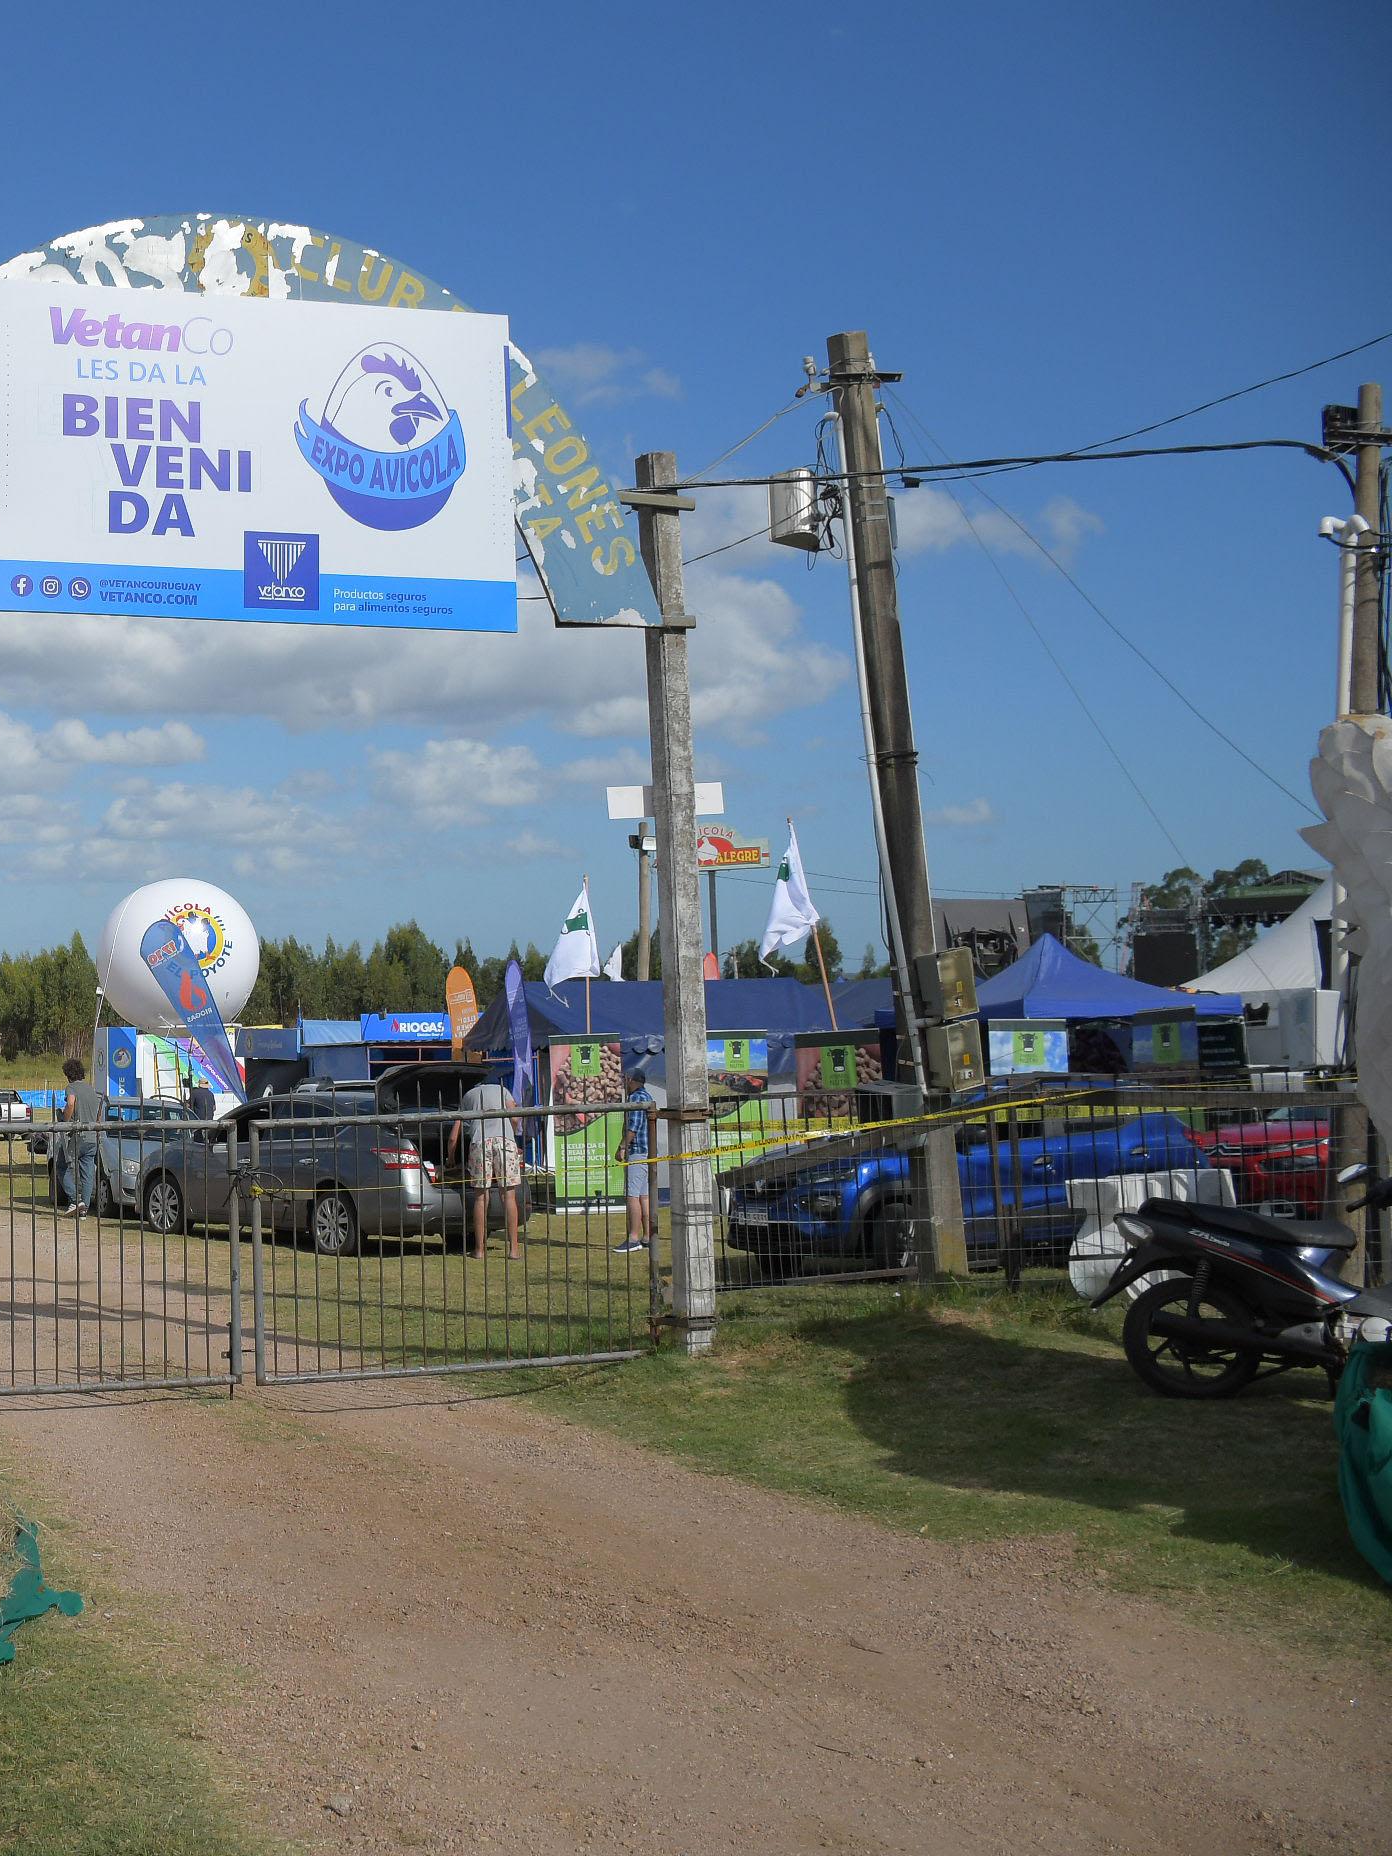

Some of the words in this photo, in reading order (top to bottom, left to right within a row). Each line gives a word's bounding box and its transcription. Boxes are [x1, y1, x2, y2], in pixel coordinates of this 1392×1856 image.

[49, 306, 233, 356] VetanCo
[76, 358, 119, 380] LES
[128, 361, 165, 384] DA
[175, 364, 207, 386] LA
[62, 393, 201, 443] BIEN
[110, 443, 252, 493] VENI
[310, 434, 365, 485] EXPO
[369, 433, 461, 493] AVICOLA
[108, 490, 196, 538] DA
[99, 579, 202, 592] @VETANCOURUGUAY
[258, 581, 305, 600] vetanco
[99, 590, 198, 606] VETANCO.COM
[333, 588, 384, 600] Productos
[386, 593, 427, 603] seguros
[333, 602, 356, 613] para
[358, 602, 409, 613] alimentos
[412, 603, 453, 616] seguros
[698, 826, 734, 839] ICOLA
[716, 849, 759, 863] ALEGRE
[399, 1021, 444, 1033] RIOGAS
